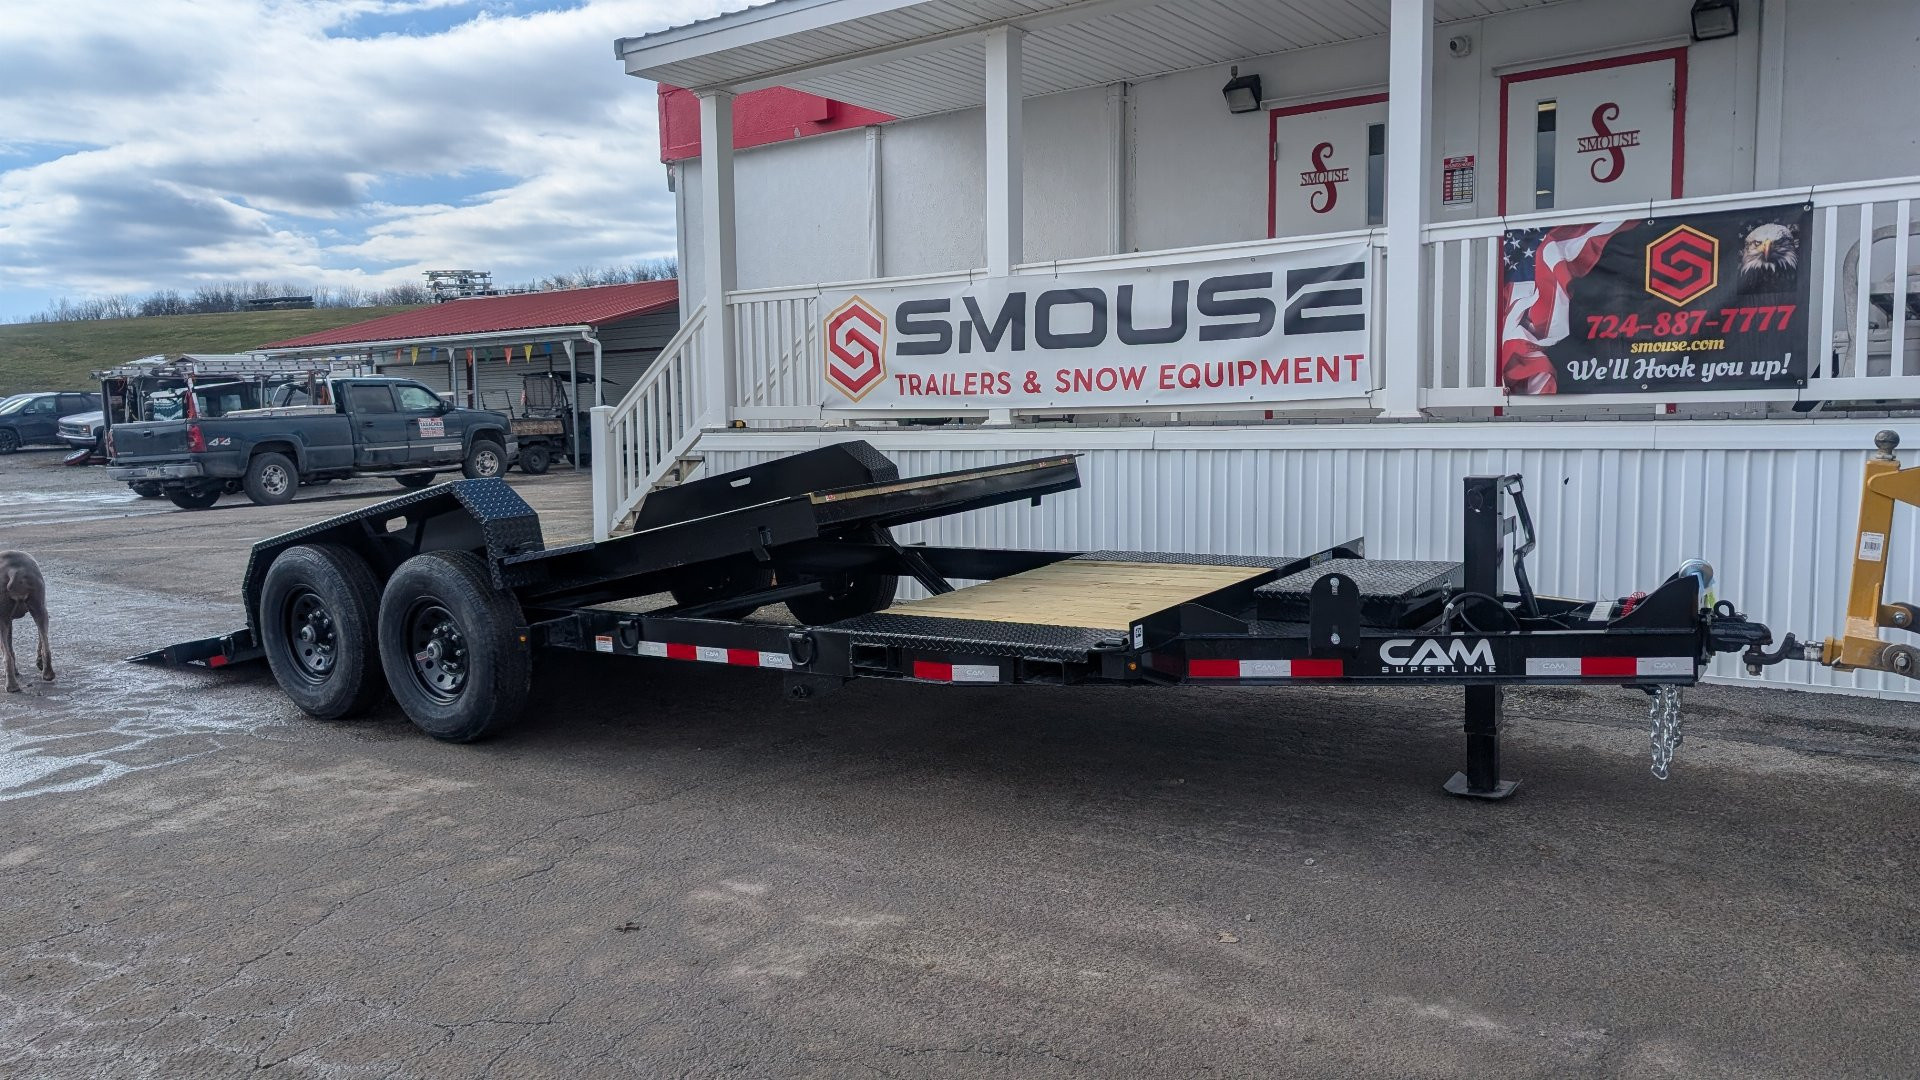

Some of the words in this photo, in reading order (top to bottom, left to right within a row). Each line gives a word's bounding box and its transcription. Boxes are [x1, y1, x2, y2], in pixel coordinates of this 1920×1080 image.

[1577, 130, 1640, 153] SMOUSE
[1300, 168, 1349, 186] SMOUSE
[895, 262, 1366, 356] SMOUSE
[1586, 304, 1797, 340] 724-887-7777
[1630, 337, 1725, 354] smouse.com
[895, 372, 1011, 397] TRAILERS
[1023, 371, 1042, 394] &
[1055, 366, 1148, 393] SNOW
[1159, 353, 1365, 389] EQUIPMENT
[1567, 357, 1628, 381] We'll
[1629, 355, 1697, 379] Hook
[1701, 361, 1745, 384] you
[1750, 352, 1792, 382] up!
[1379, 639, 1496, 665] CAM
